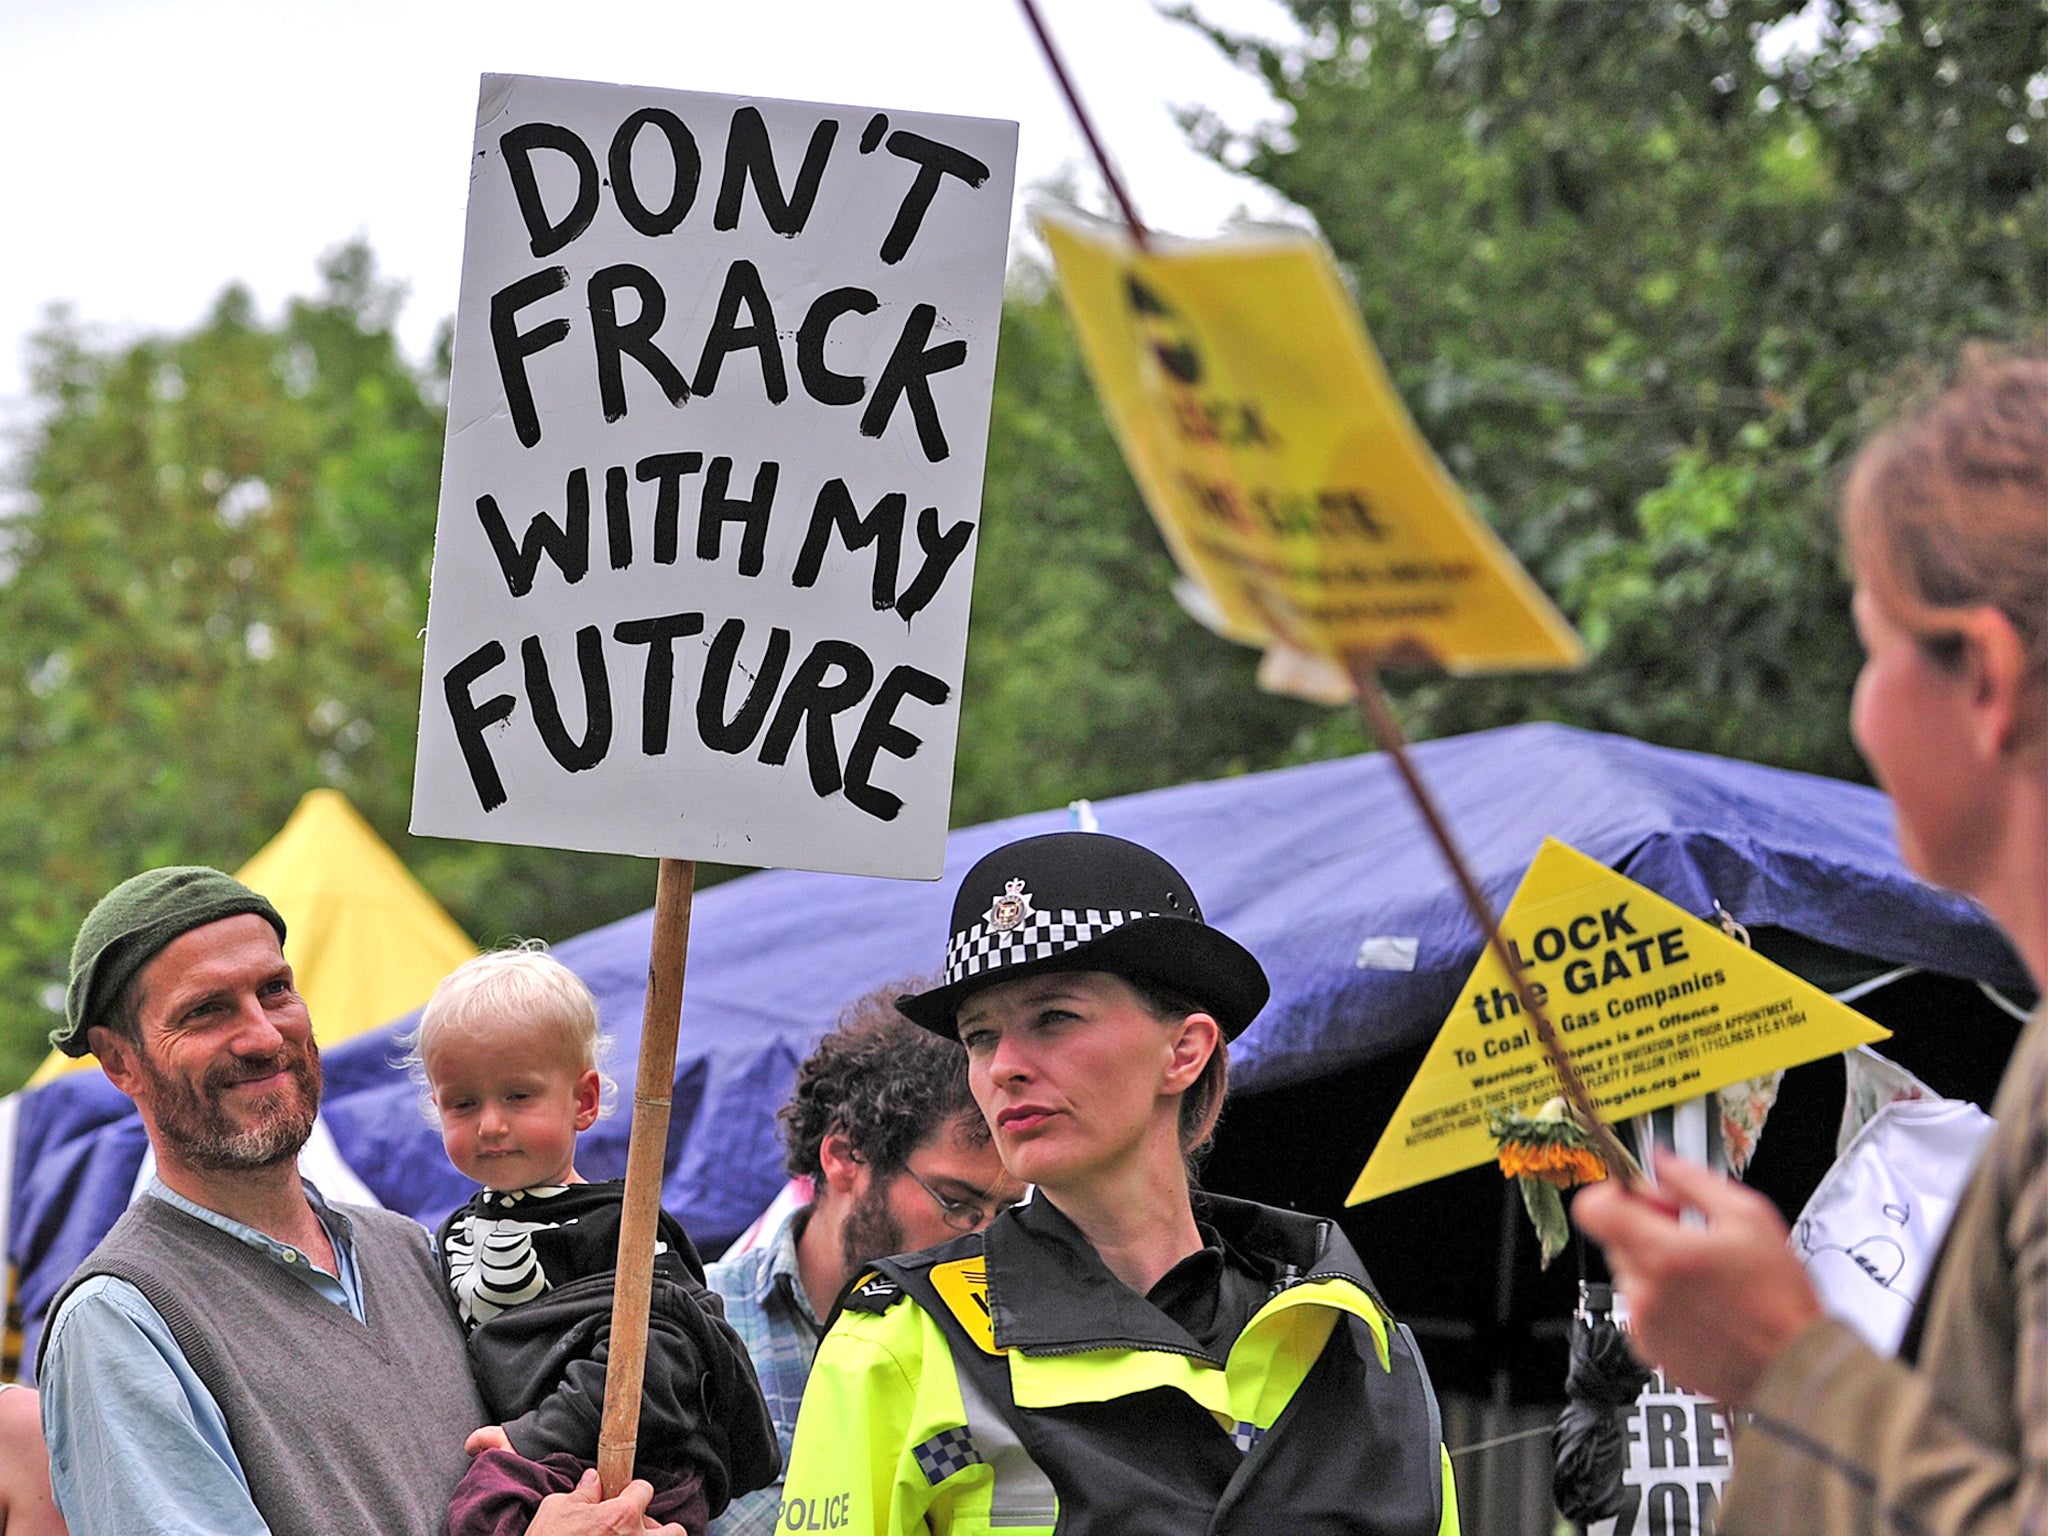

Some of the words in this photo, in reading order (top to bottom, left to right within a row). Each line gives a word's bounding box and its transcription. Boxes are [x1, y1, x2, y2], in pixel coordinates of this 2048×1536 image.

[500, 106, 991, 265] DON'T
[490, 259, 968, 462] FRACK
[476, 451, 780, 598] WITH
[792, 478, 975, 623] MY
[443, 611, 952, 821] FUTURE
[1473, 980, 1549, 1025] the
[1563, 927, 1690, 996] GATE
[1507, 902, 1637, 971] LOCK
[1454, 1048, 1477, 1068] To
[1484, 1028, 1531, 1059] Coal
[1561, 1012, 1601, 1034] Gas
[1606, 968, 1727, 1020] Companies
[1616, 1031, 1630, 1043] is
[1635, 1025, 1655, 1039] an
[1659, 1003, 1720, 1030] Offence
[1591, 1069, 1702, 1110] thegate.org.au
[777, 1491, 850, 1531] POLICE
